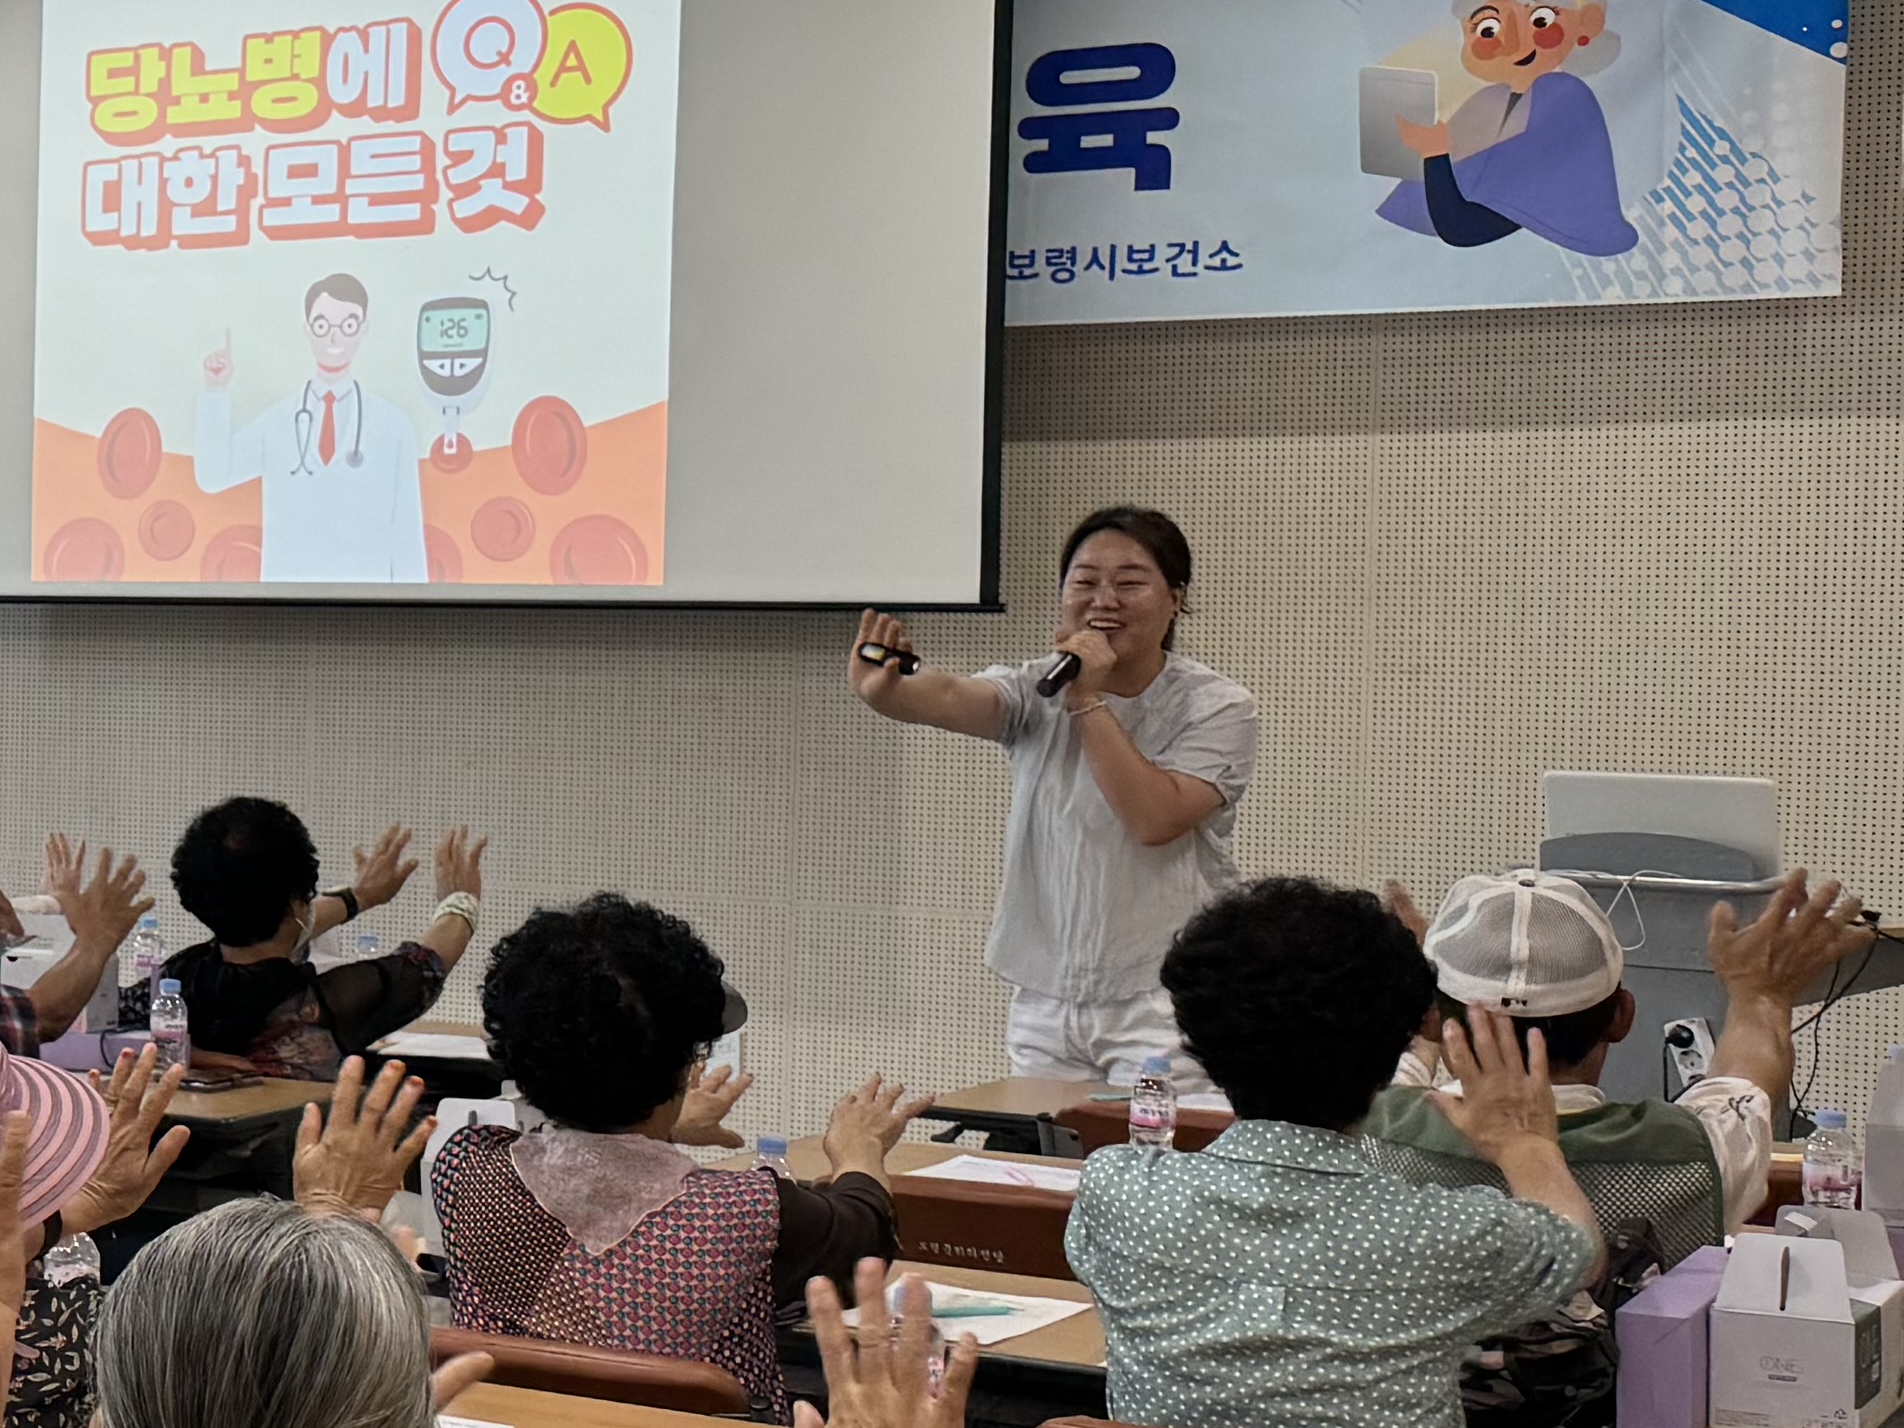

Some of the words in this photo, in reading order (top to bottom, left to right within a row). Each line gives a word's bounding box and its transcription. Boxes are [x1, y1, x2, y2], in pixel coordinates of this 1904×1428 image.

[87, 20, 417, 140] 당뇨병에
[1017, 41, 1180, 192] 육
[84, 146, 252, 244] 대한
[260, 133, 433, 234] 모든
[445, 124, 542, 227] 것
[1005, 240, 1243, 283] 보령시보건소
[440, 317, 468, 340] 126
